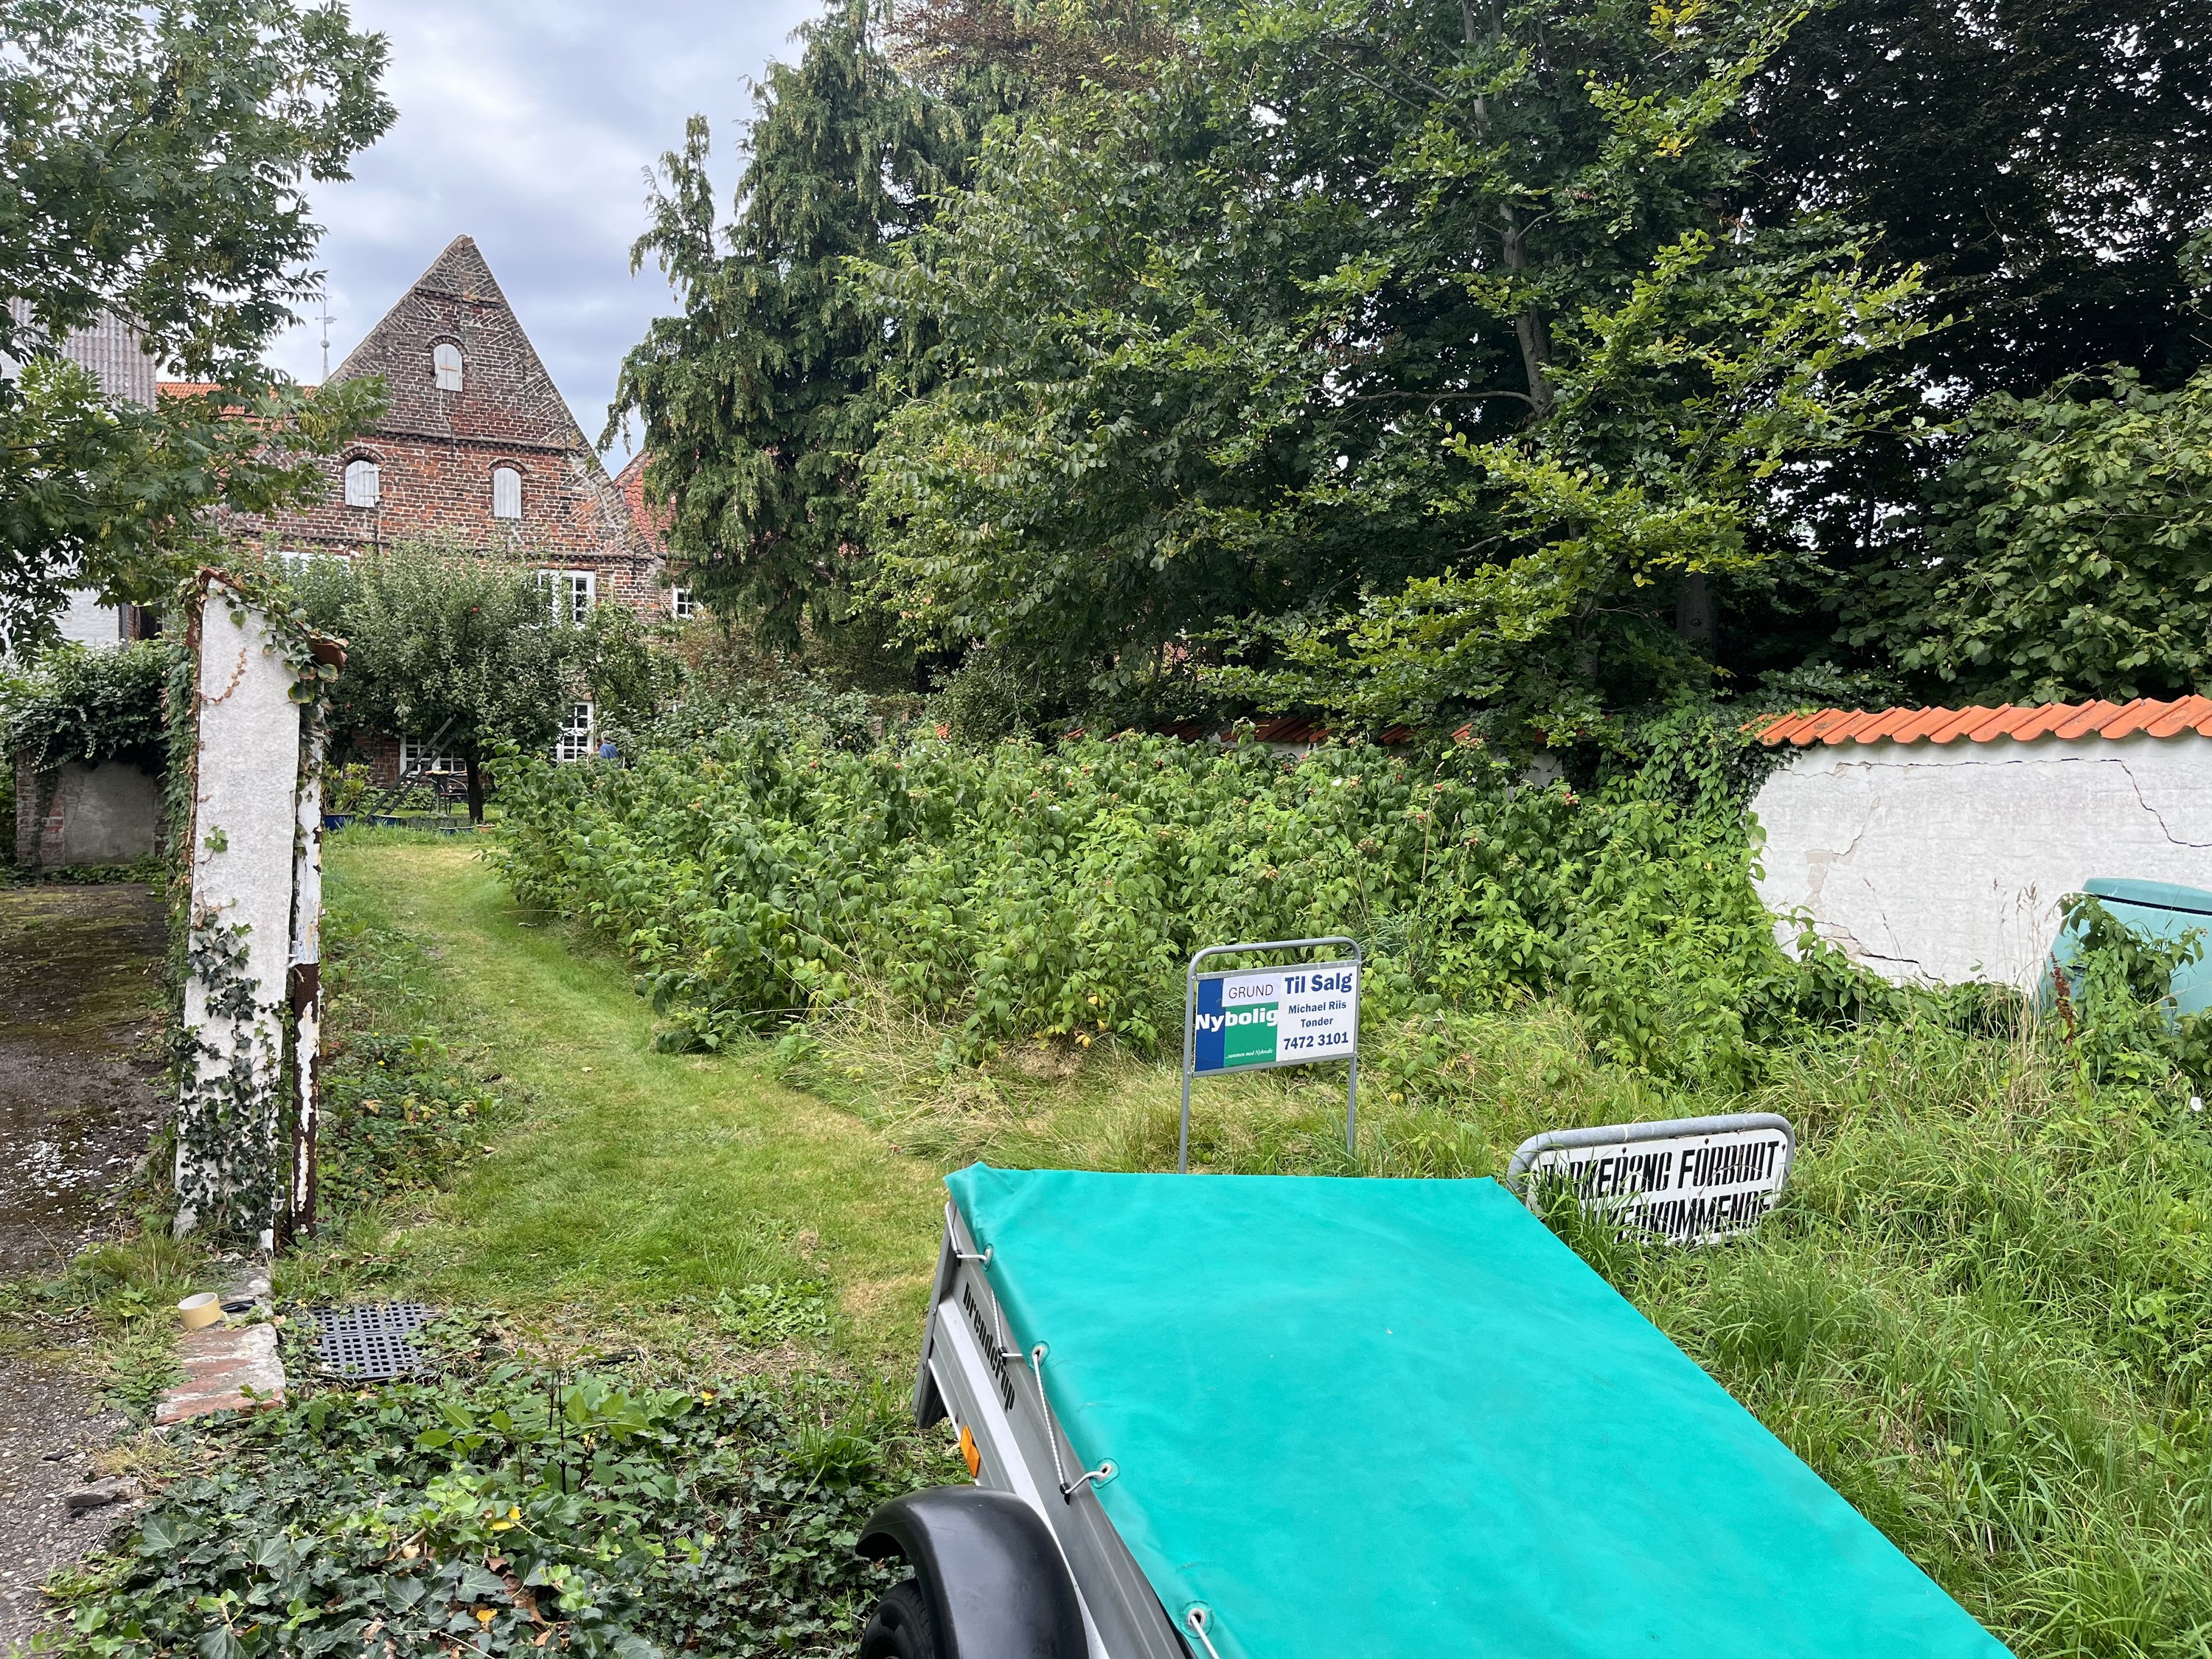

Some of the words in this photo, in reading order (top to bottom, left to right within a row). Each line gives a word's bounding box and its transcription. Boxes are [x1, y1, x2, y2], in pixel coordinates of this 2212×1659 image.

[1228, 984, 1273, 999] GRUND
[1284, 975, 1305, 994] Til
[1311, 973, 1352, 992] Salg
[1288, 1002, 1326, 1015] Michael
[1329, 1000, 1347, 1010] Riis
[1195, 1007, 1279, 1032] Nybolig
[1301, 1018, 1333, 1028] Tønder
[1284, 1035, 1314, 1050] 7472
[1318, 1032, 1349, 1046] 3101
[1678, 1141, 1780, 1189] FORBUDT
[963, 1281, 1015, 1413] brenderup
